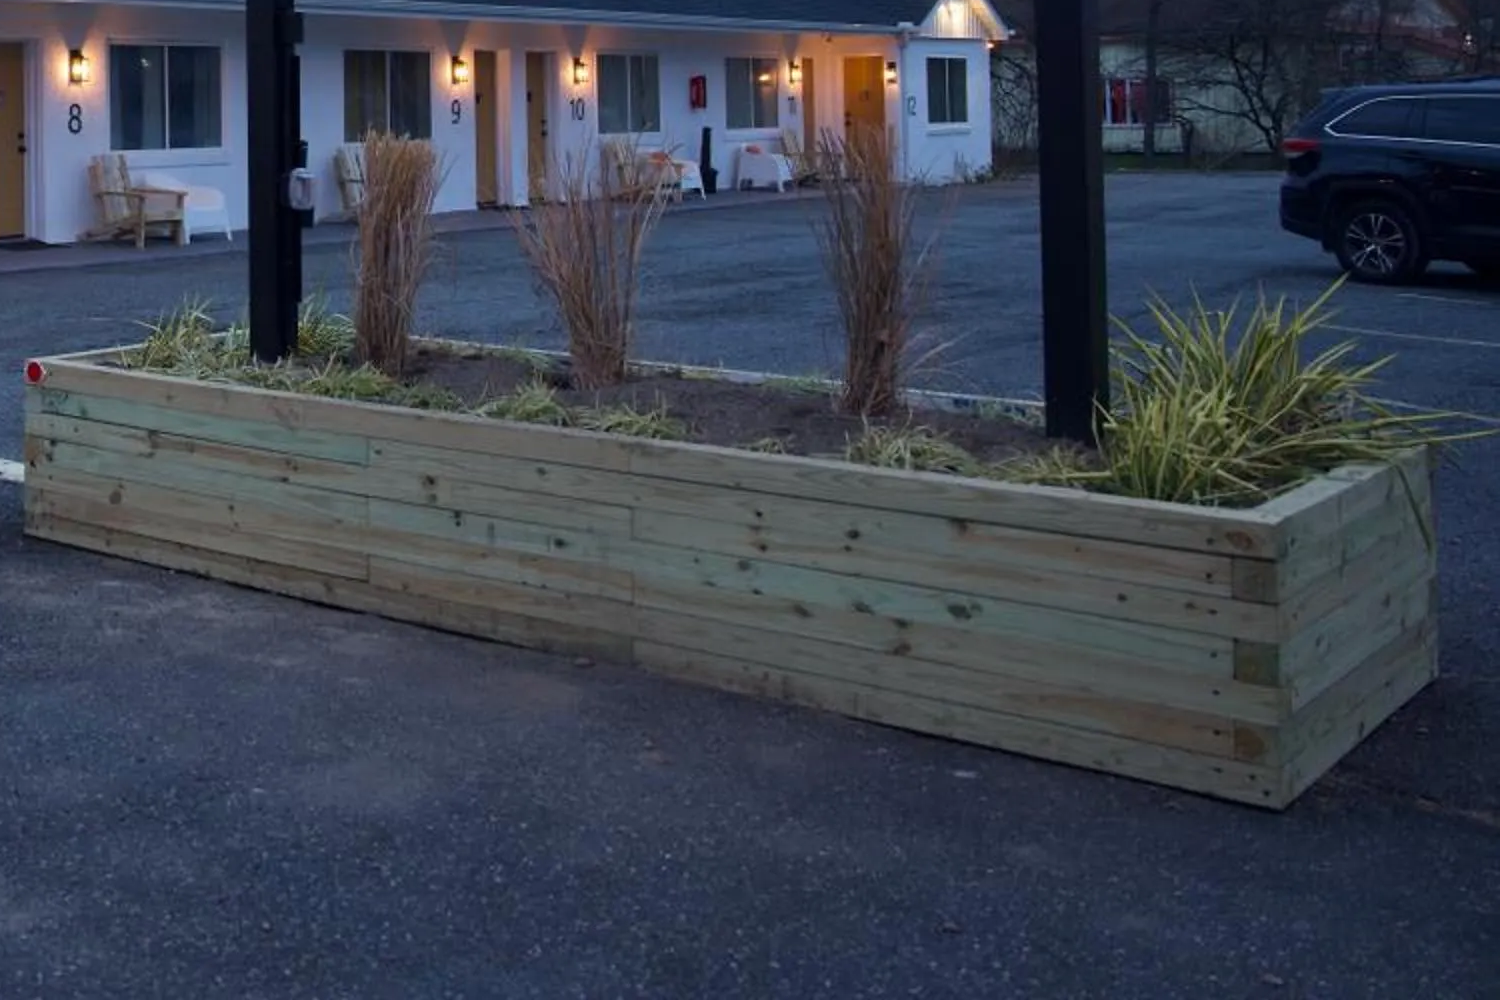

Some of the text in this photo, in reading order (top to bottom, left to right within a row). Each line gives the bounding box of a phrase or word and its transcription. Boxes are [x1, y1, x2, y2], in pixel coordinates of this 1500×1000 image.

[67, 103, 83, 135] 8
[451, 99, 461, 124] 9
[569, 97, 585, 121] 10
